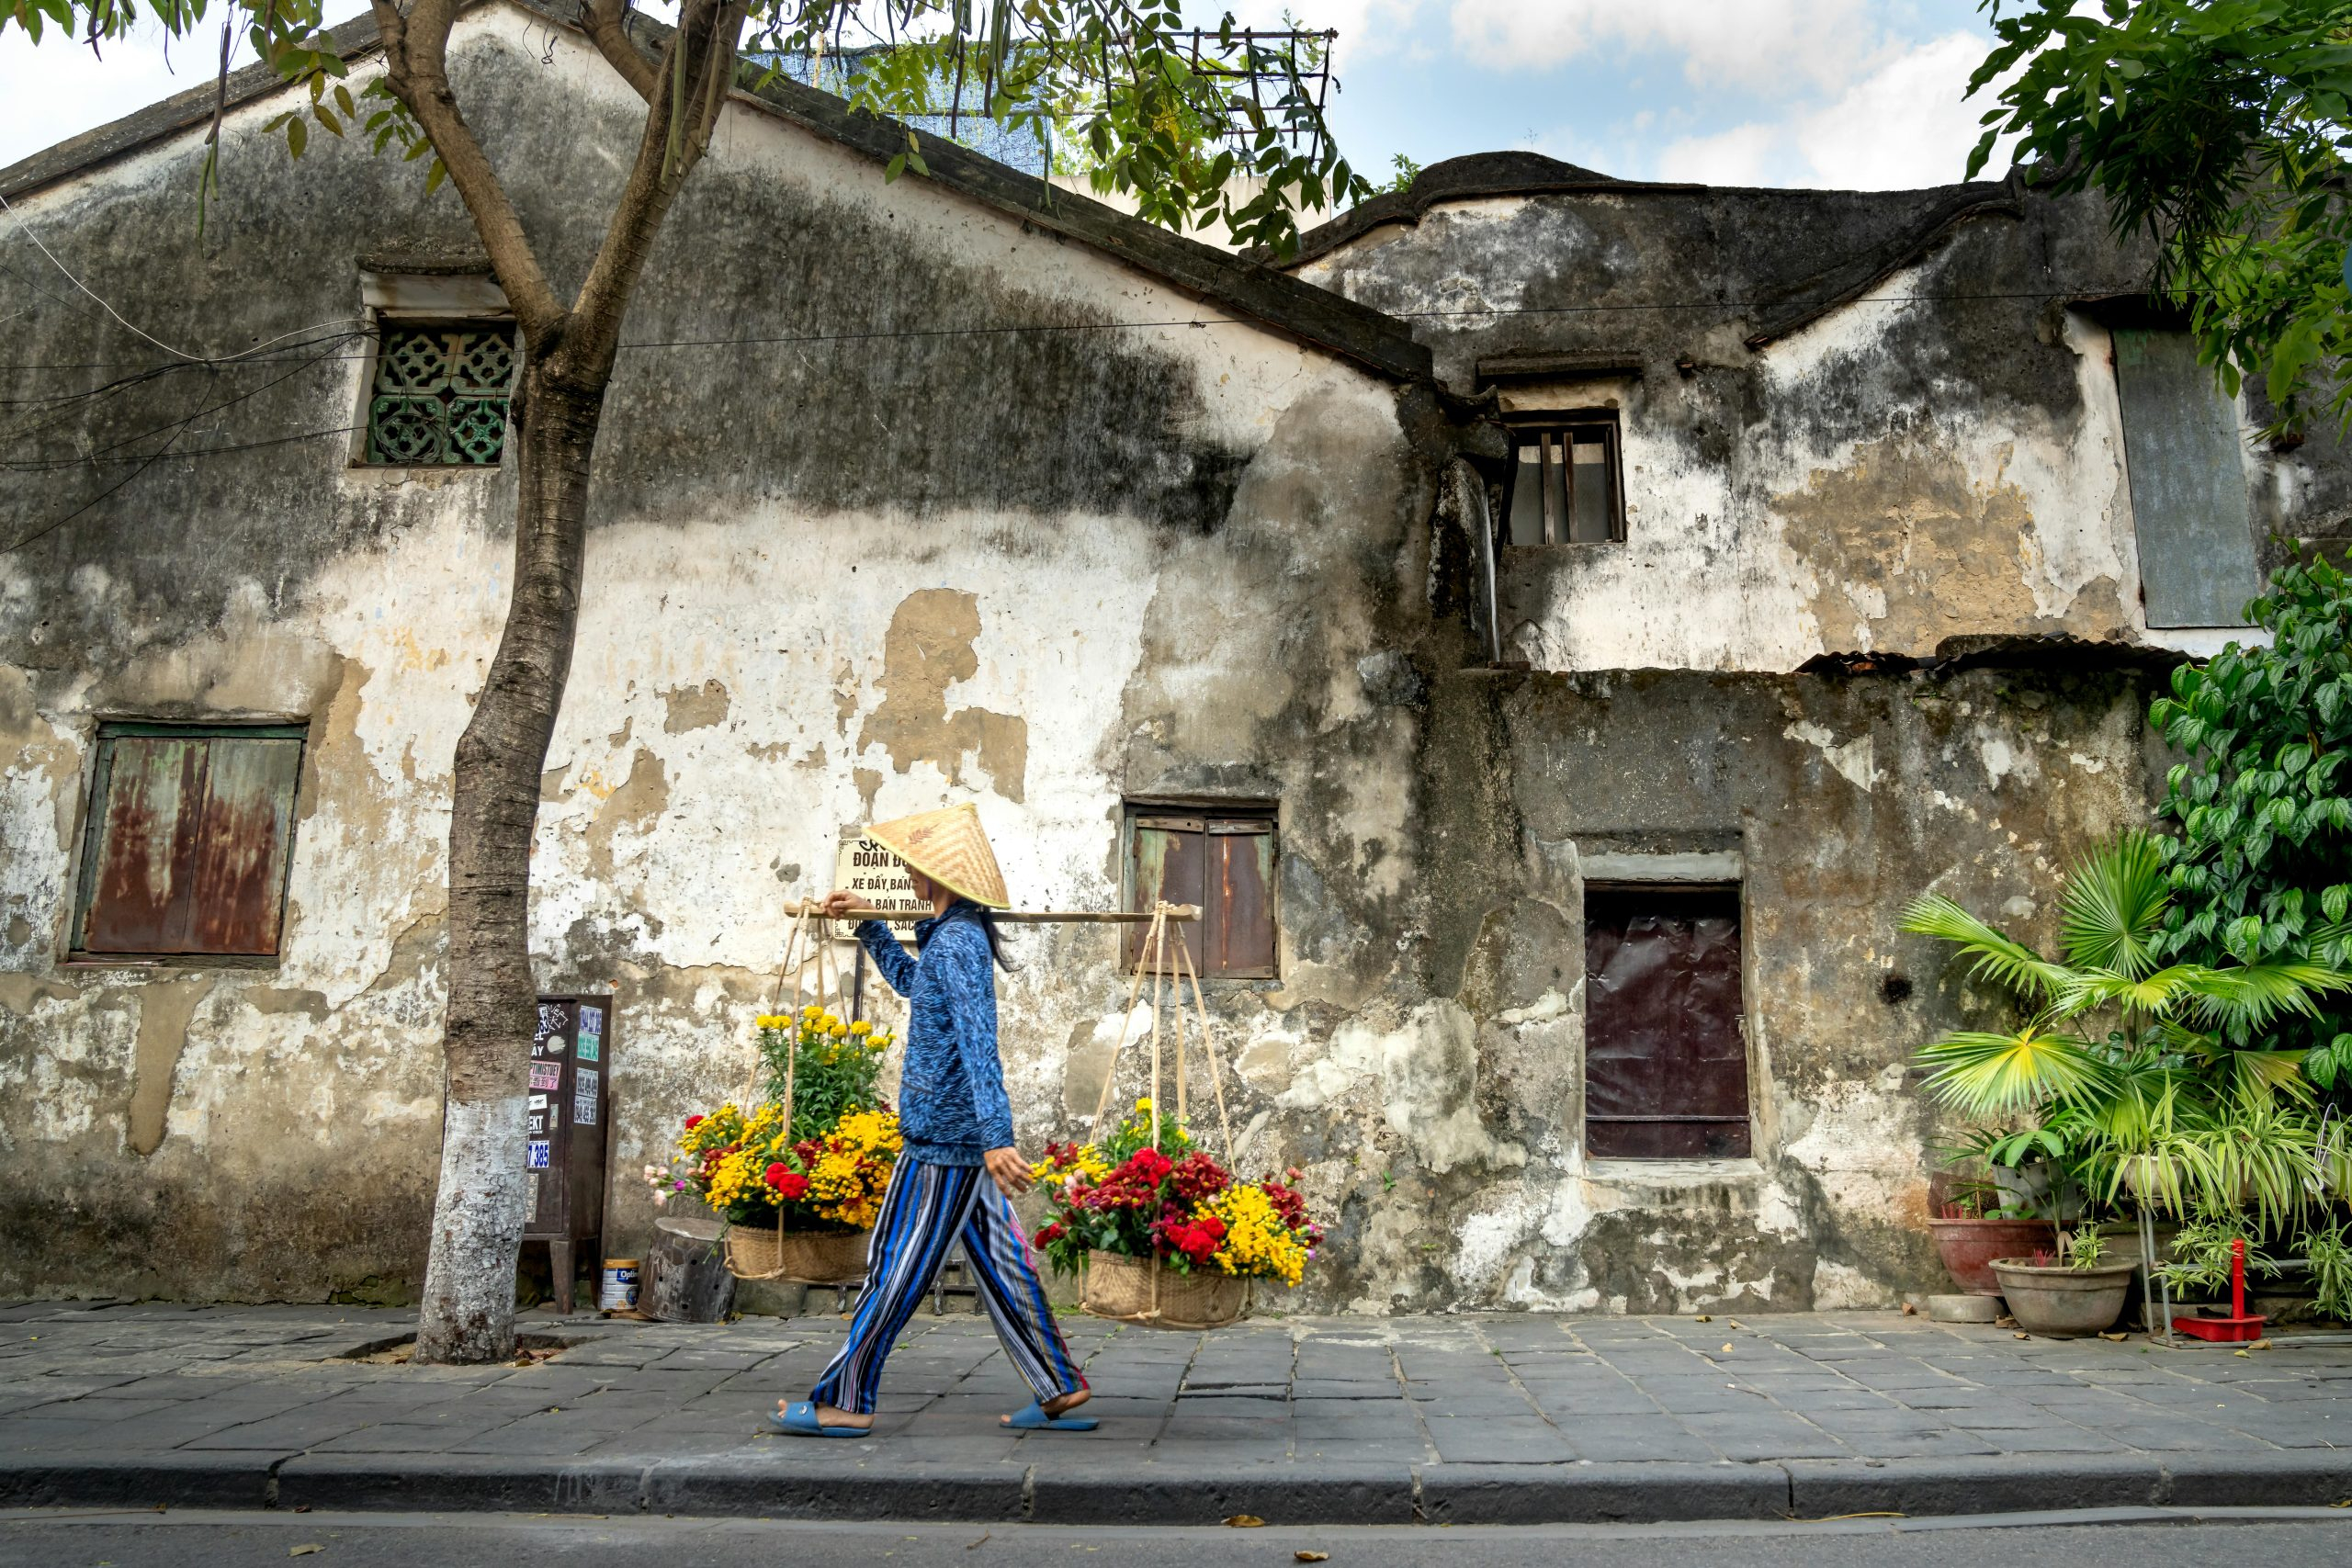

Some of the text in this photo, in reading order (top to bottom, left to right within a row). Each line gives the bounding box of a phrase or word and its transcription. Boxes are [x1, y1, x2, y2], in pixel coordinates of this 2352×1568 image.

[853, 852, 888, 870] ĐOẠN
[852, 878, 865, 889] XE
[890, 876, 911, 890] BÁN
[876, 897, 896, 910] BÁN
[899, 899, 932, 910] TRANH
